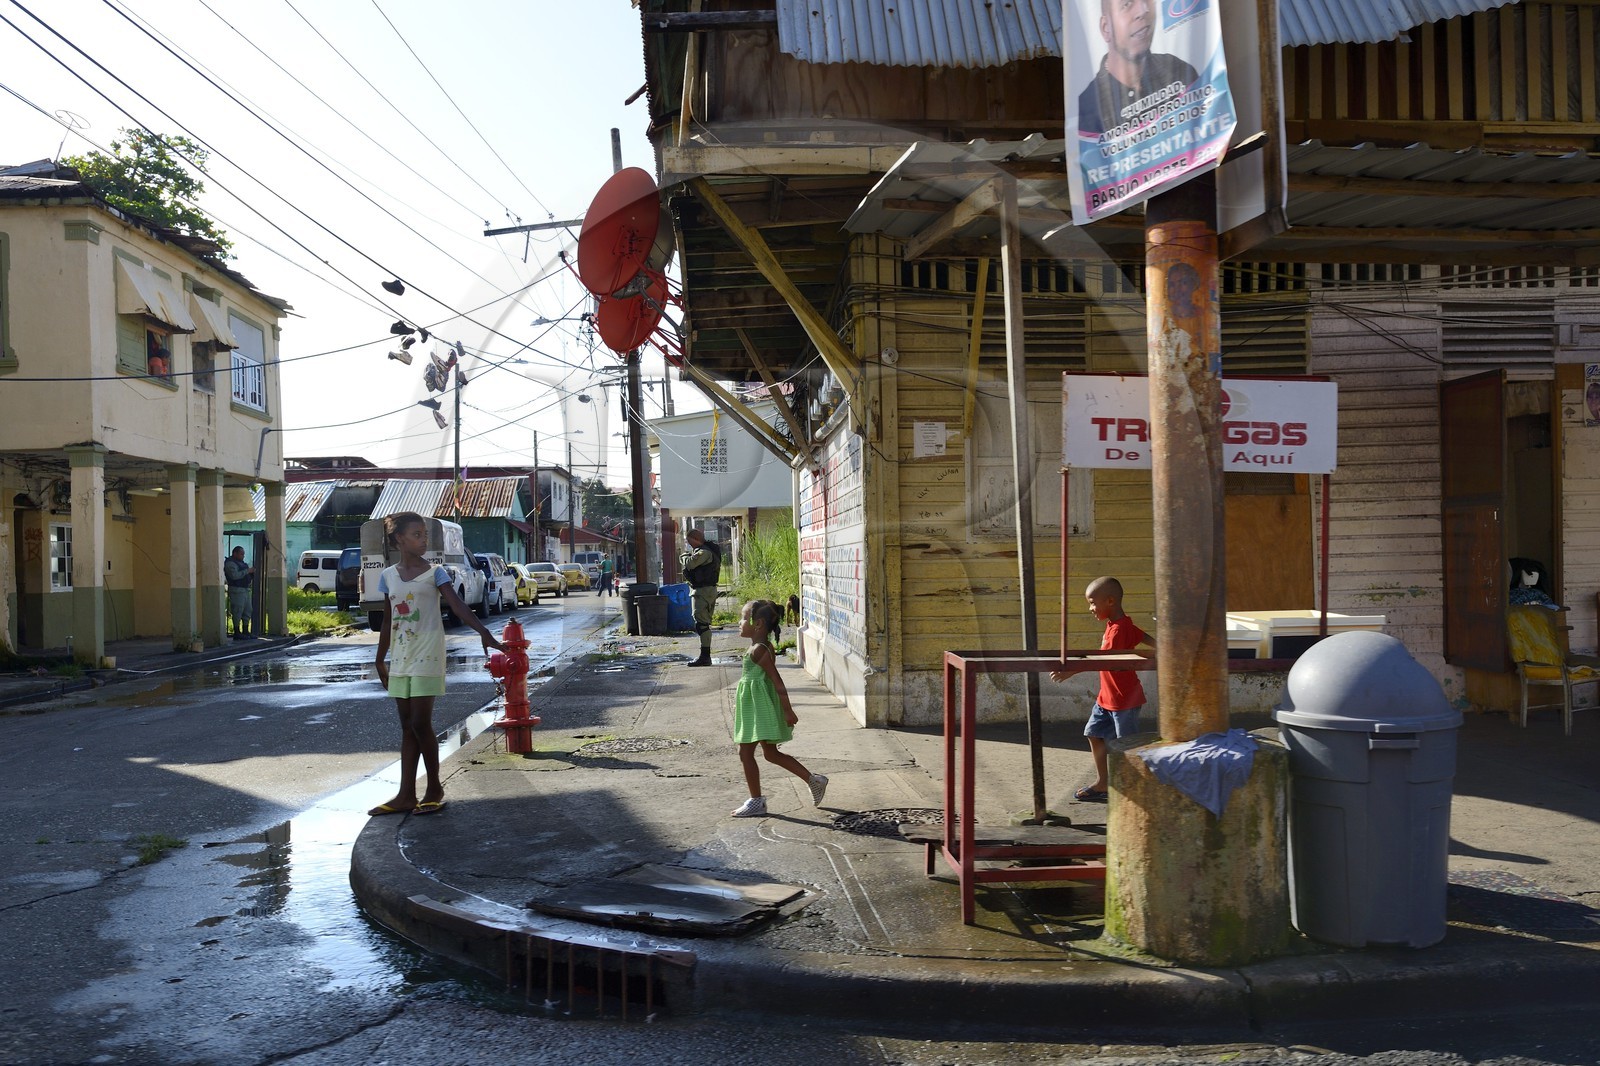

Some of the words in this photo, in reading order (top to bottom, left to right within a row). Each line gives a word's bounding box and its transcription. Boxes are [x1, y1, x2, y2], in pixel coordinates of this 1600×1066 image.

[1098, 121, 1130, 144] AMOR
[1130, 117, 1140, 129] A
[1140, 110, 1156, 124] TU
[1102, 125, 1158, 157] VOLUNTAD
[1160, 116, 1175, 131] DE
[1087, 114, 1231, 185] REPRESENTANTE
[1092, 178, 1139, 208] BARRIO
[1106, 448, 1140, 461] De
[1231, 451, 1295, 467] Aquí
